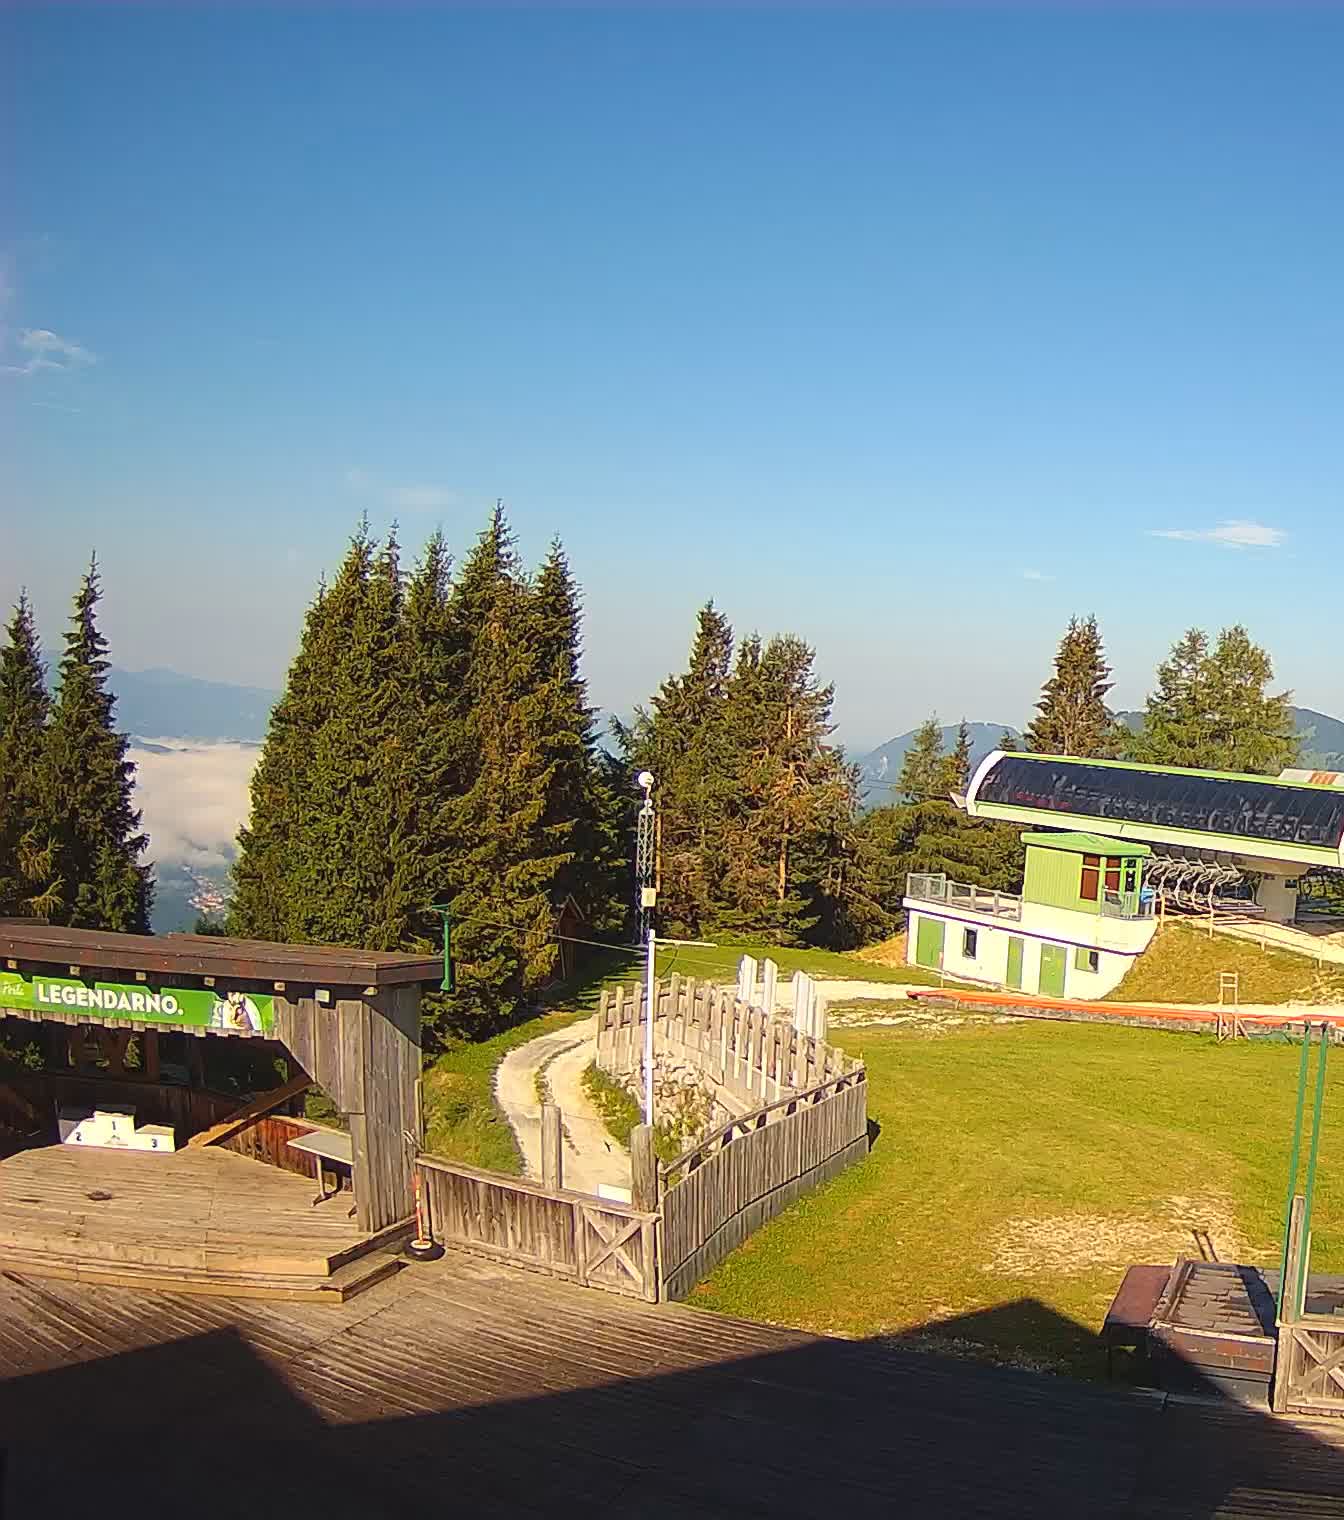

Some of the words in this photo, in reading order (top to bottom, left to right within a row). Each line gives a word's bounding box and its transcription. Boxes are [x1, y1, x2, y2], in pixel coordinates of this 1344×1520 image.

[39, 984, 184, 1015] LEGENDARNO.
[75, 1132, 82, 1142] 2
[151, 1139, 158, 1148] 3
